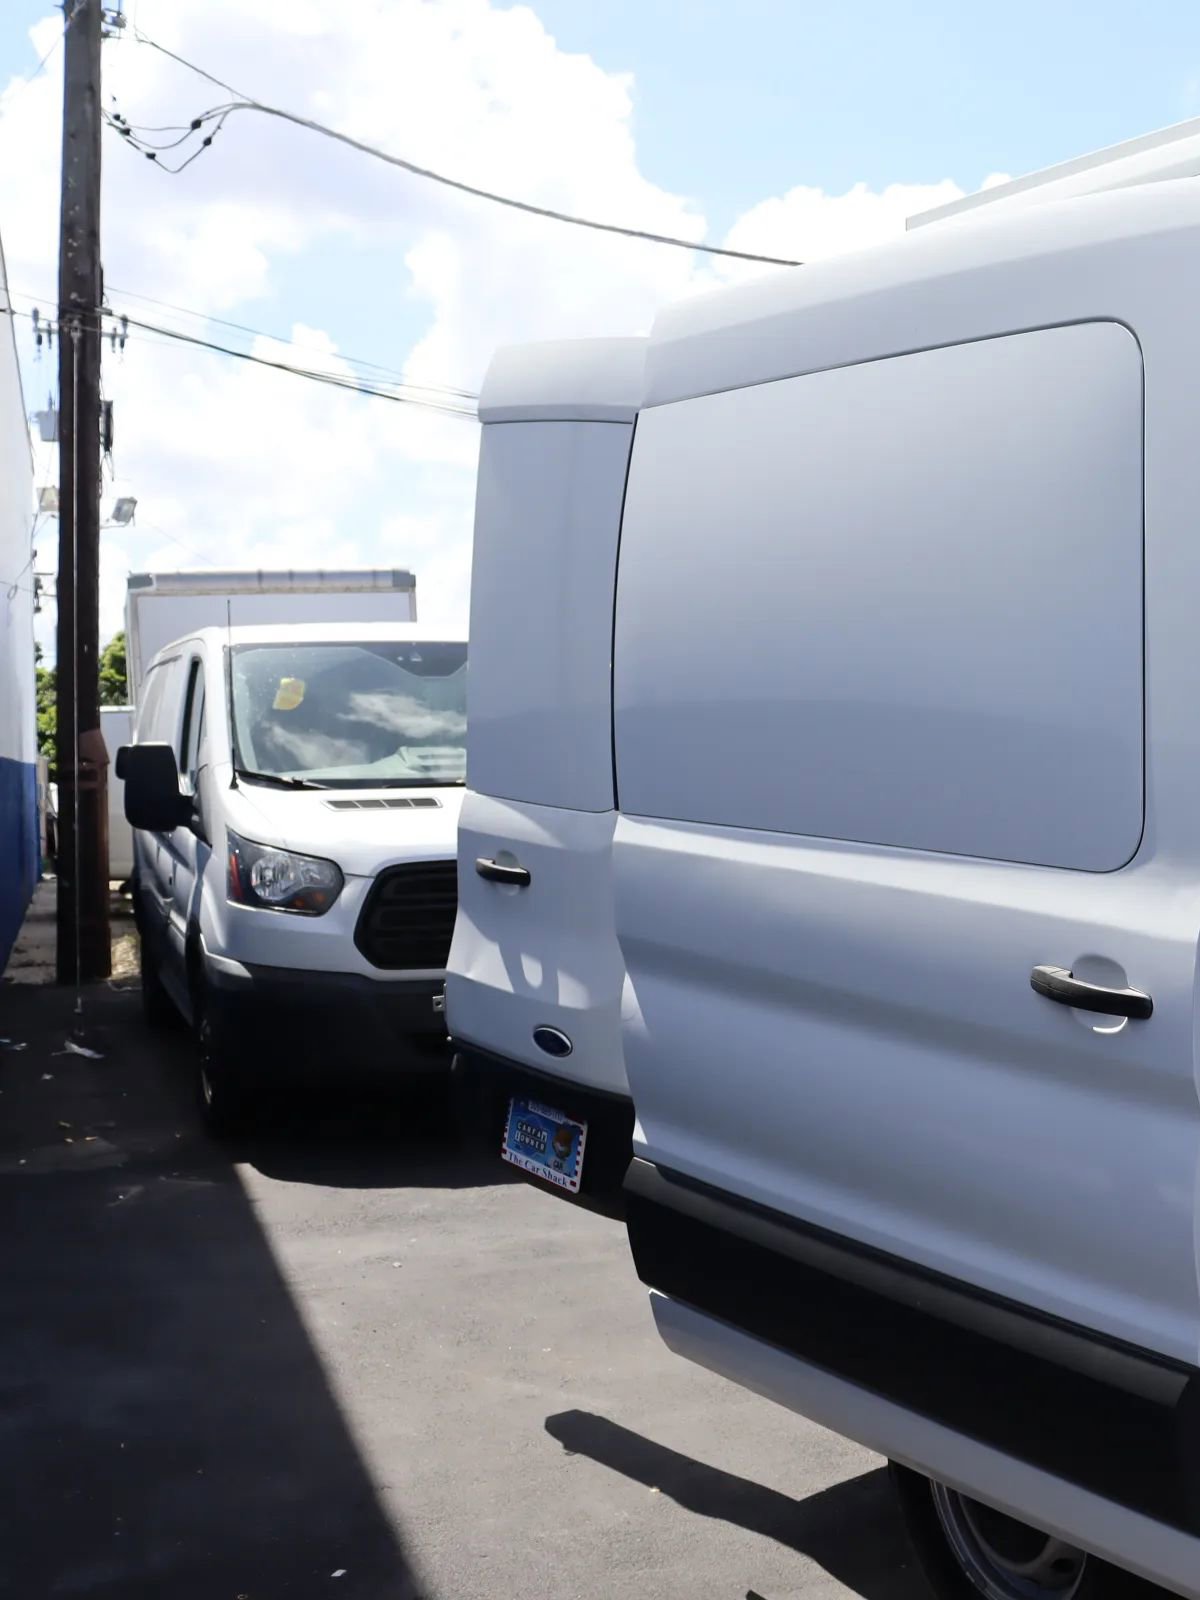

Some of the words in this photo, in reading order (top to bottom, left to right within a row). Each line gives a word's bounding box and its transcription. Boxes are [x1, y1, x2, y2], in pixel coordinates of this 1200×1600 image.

[509, 1152, 522, 1165] The
[524, 1160, 539, 1174] Car
[543, 1168, 567, 1187] Shack
